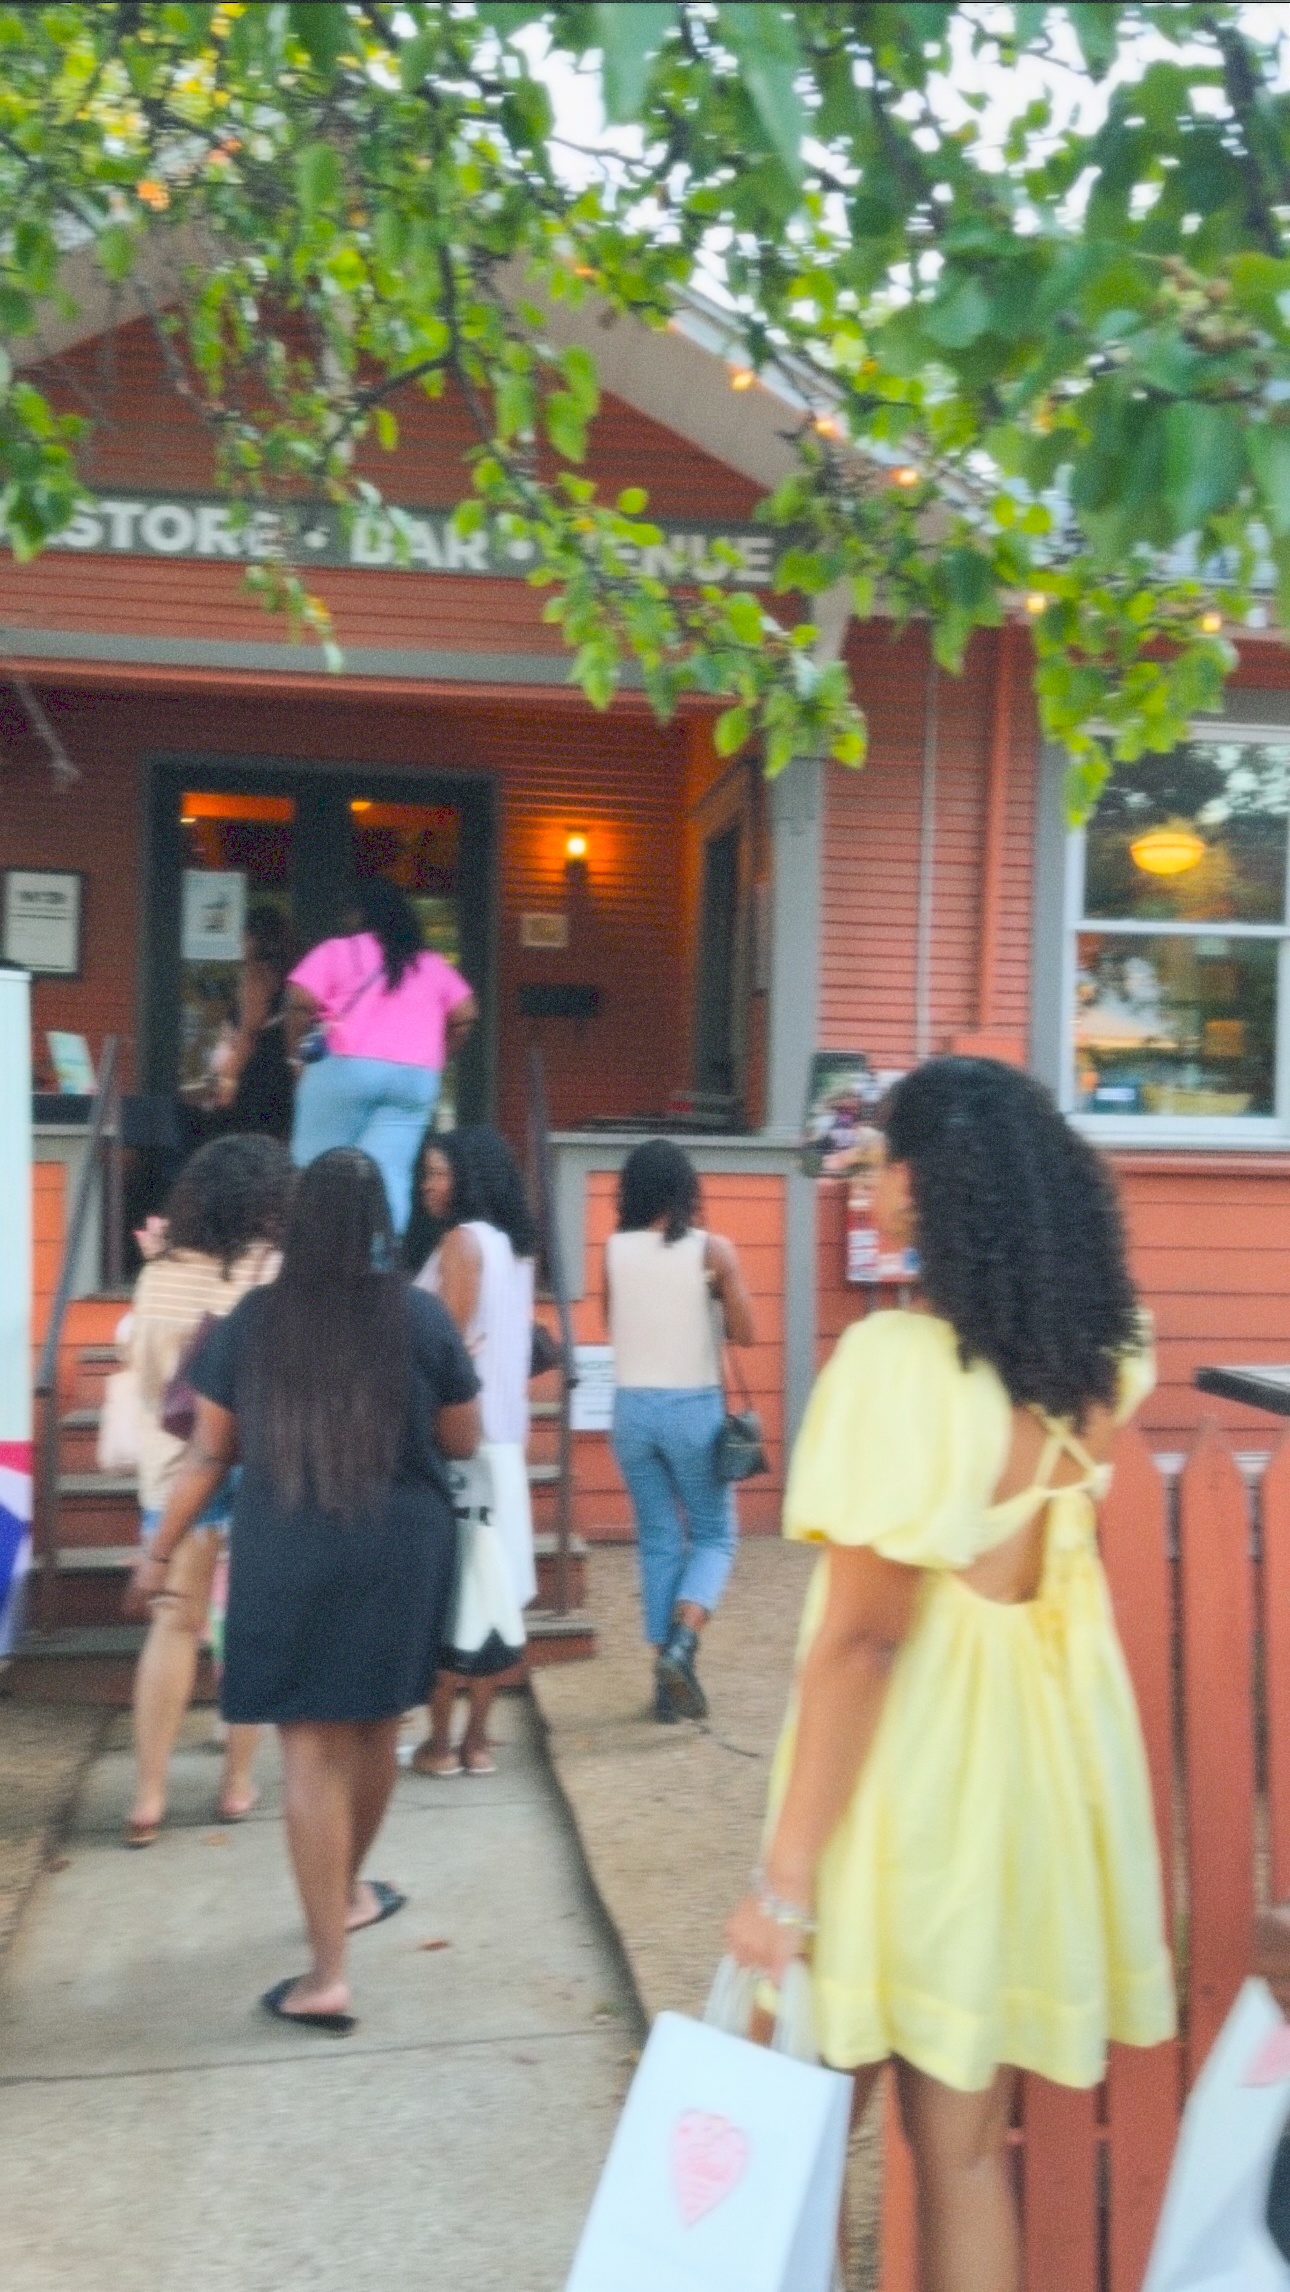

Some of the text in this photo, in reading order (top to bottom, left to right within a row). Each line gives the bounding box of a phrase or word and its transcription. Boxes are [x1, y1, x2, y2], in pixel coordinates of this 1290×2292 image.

[45, 499, 775, 583] STORE BAR ENUE
